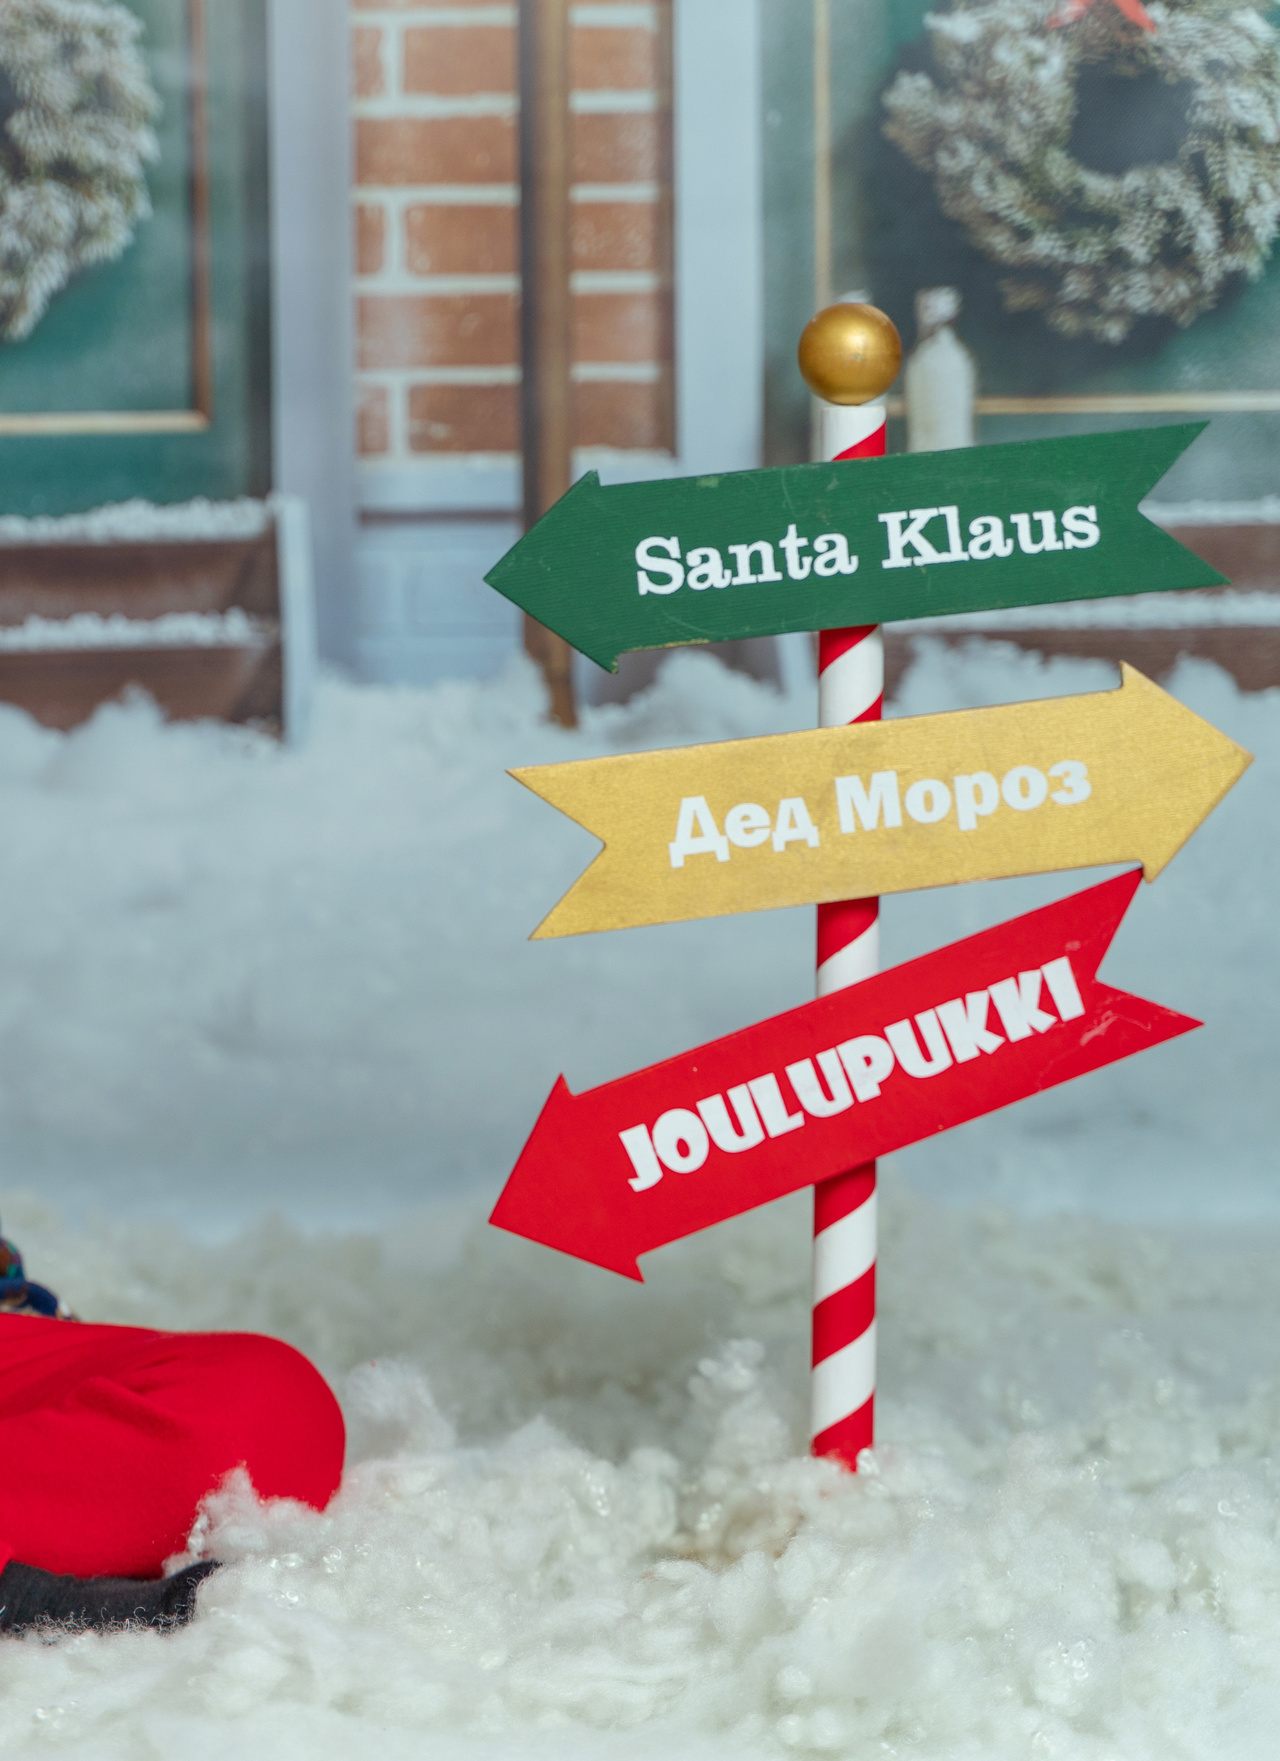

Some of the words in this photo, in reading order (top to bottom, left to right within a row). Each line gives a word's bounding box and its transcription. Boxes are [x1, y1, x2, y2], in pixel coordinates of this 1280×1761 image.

[635, 522, 858, 596] Santa
[878, 504, 1101, 569] Klaus
[669, 795, 819, 868] Дед
[835, 759, 1092, 830] Мороз
[619, 956, 1085, 1192] JOULUPUKKI
